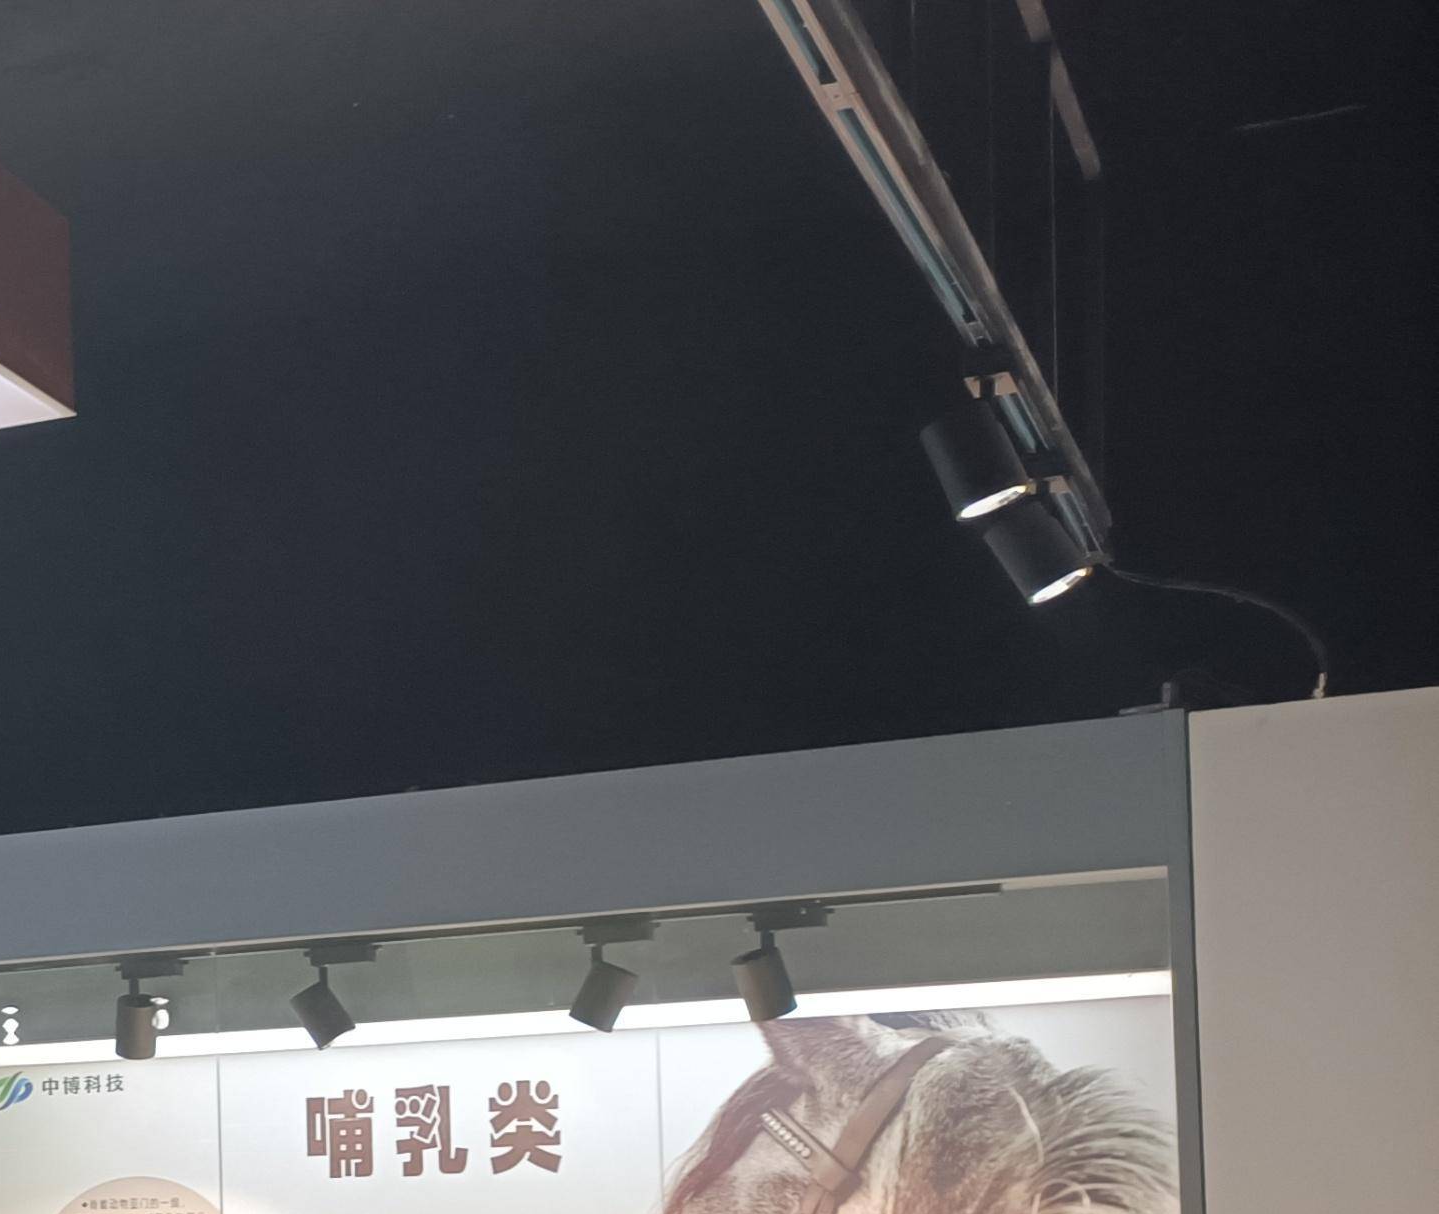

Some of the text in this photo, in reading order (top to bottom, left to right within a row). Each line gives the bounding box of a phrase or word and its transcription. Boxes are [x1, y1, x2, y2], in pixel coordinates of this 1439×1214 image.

[42, 1074, 124, 1096] 中博科技
[306, 1080, 561, 1178] 哺乳类
